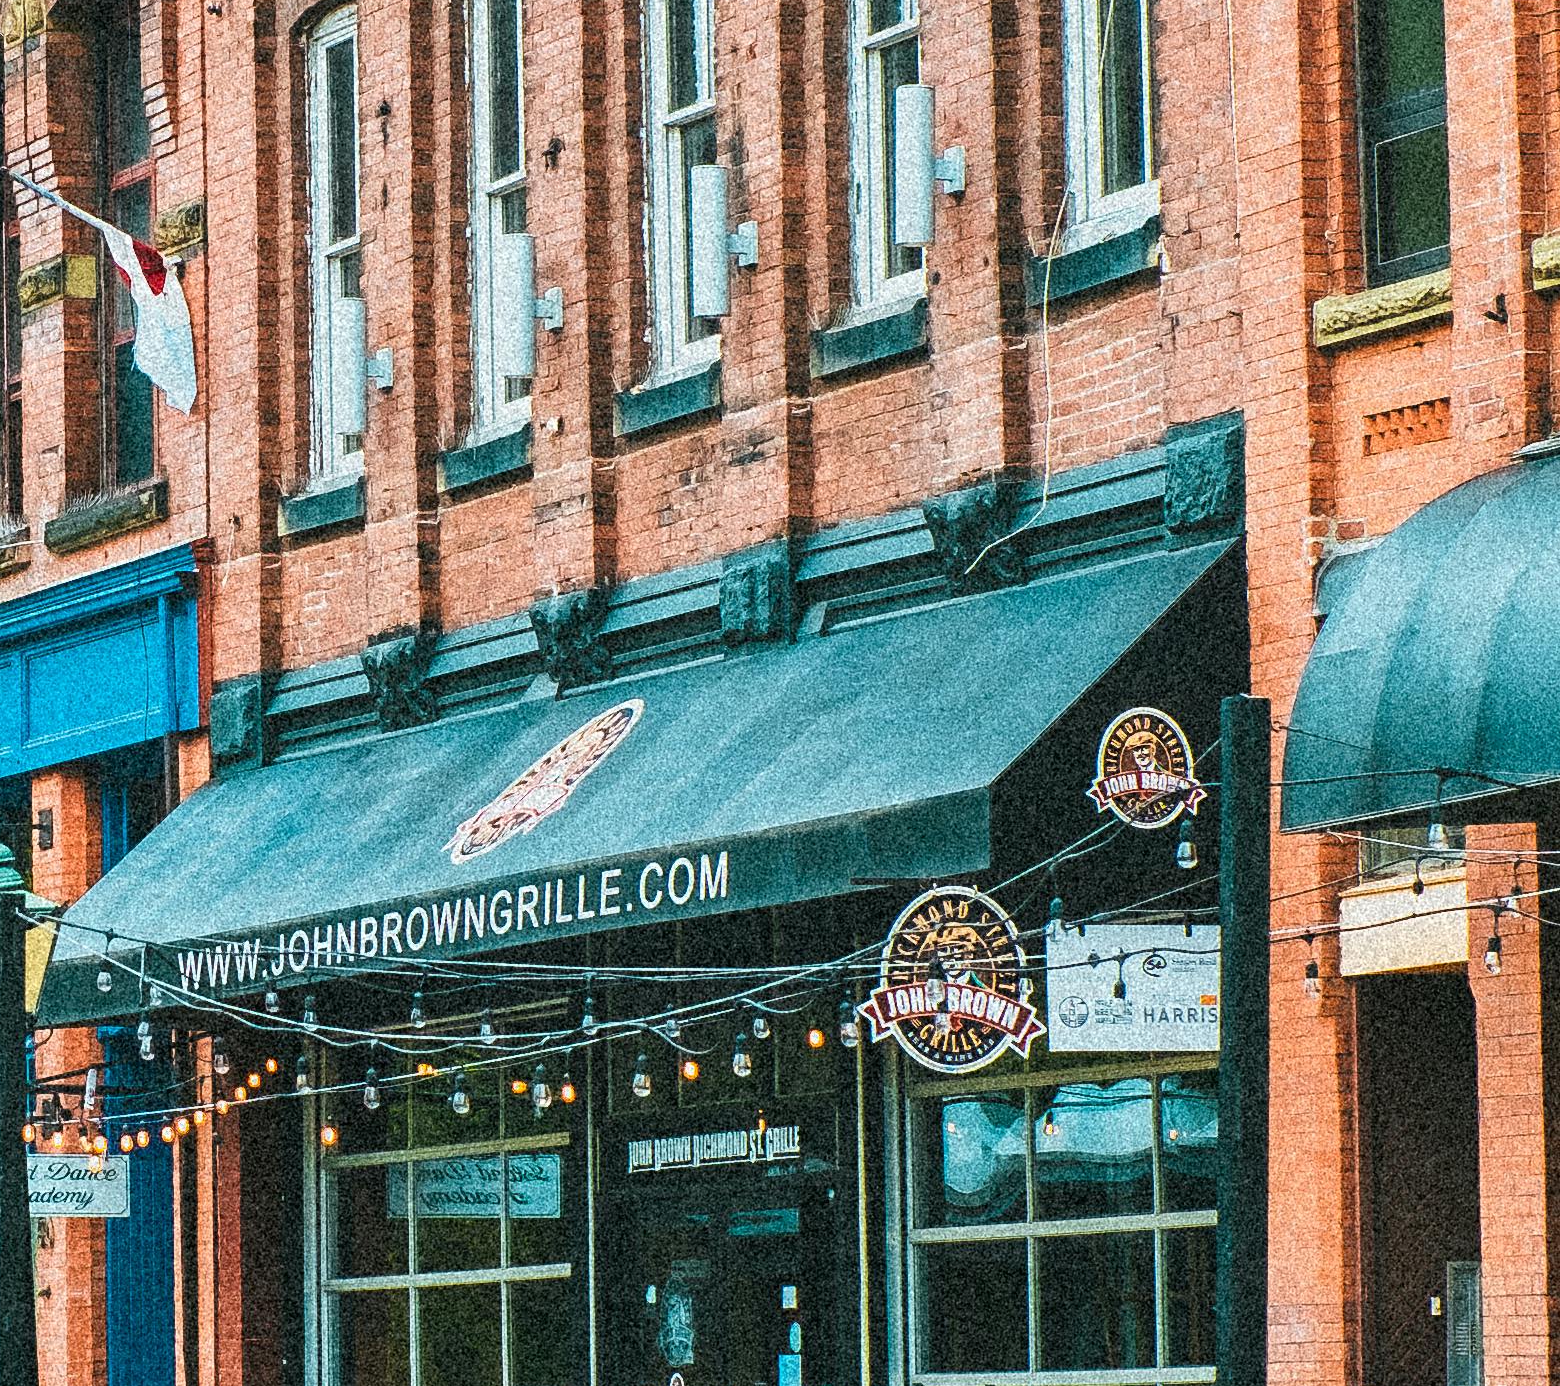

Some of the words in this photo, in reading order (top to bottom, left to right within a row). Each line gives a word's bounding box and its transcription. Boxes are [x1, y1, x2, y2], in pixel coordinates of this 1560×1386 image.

[1104, 773, 1138, 796] JOHN
[177, 852, 729, 991] WWW.JOHNBROWNGRILLE.COM
[886, 987, 937, 1016] JOHN
[947, 986, 1021, 1030] BROWN
[1144, 1007, 1218, 1024] HARRIS
[920, 1023, 981, 1052] GRILLE
[628, 1140, 653, 1173] JOHN
[654, 1136, 691, 1171] BROWN
[693, 1131, 748, 1167] RICHMOND
[766, 1126, 800, 1161] GRILLE
